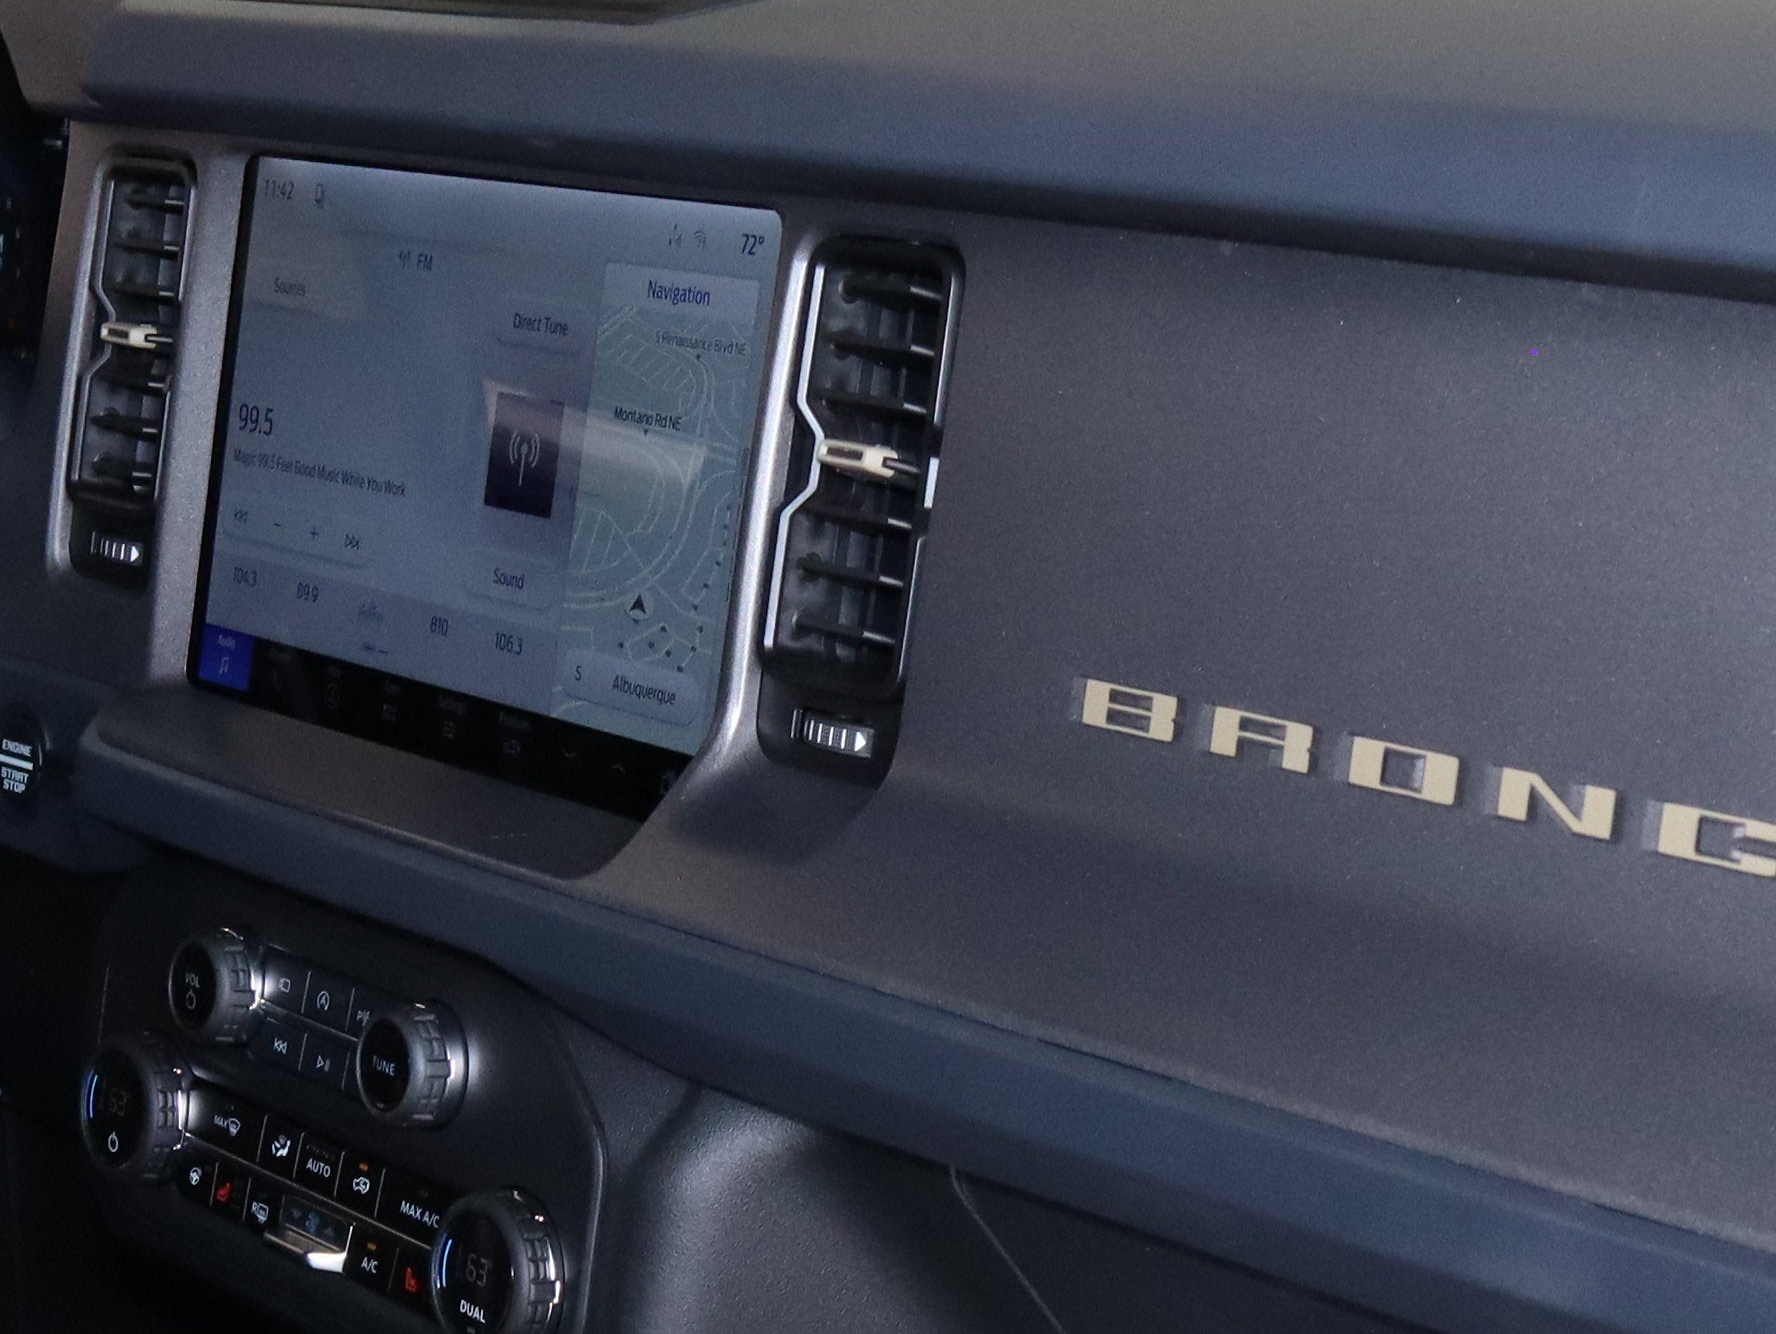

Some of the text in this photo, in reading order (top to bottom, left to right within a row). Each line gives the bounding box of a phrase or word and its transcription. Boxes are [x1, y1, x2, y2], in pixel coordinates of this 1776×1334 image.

[647, 278, 711, 307] Navigation
[512, 311, 569, 337] Direct Tune
[238, 402, 274, 437] 99.5
[492, 566, 525, 590] Sound
[494, 630, 523, 655] 106.3
[612, 674, 676, 705] Albuquerque
[0, 766, 30, 784] START
[2, 778, 26, 794] STOP
[185, 971, 201, 988] VOL
[372, 1054, 396, 1077] TUNE
[306, 1157, 331, 1179] AUTO
[400, 1199, 441, 1228] MAX A/C
[360, 1256, 379, 1274] A/C
[459, 1299, 486, 1324] DUAL
